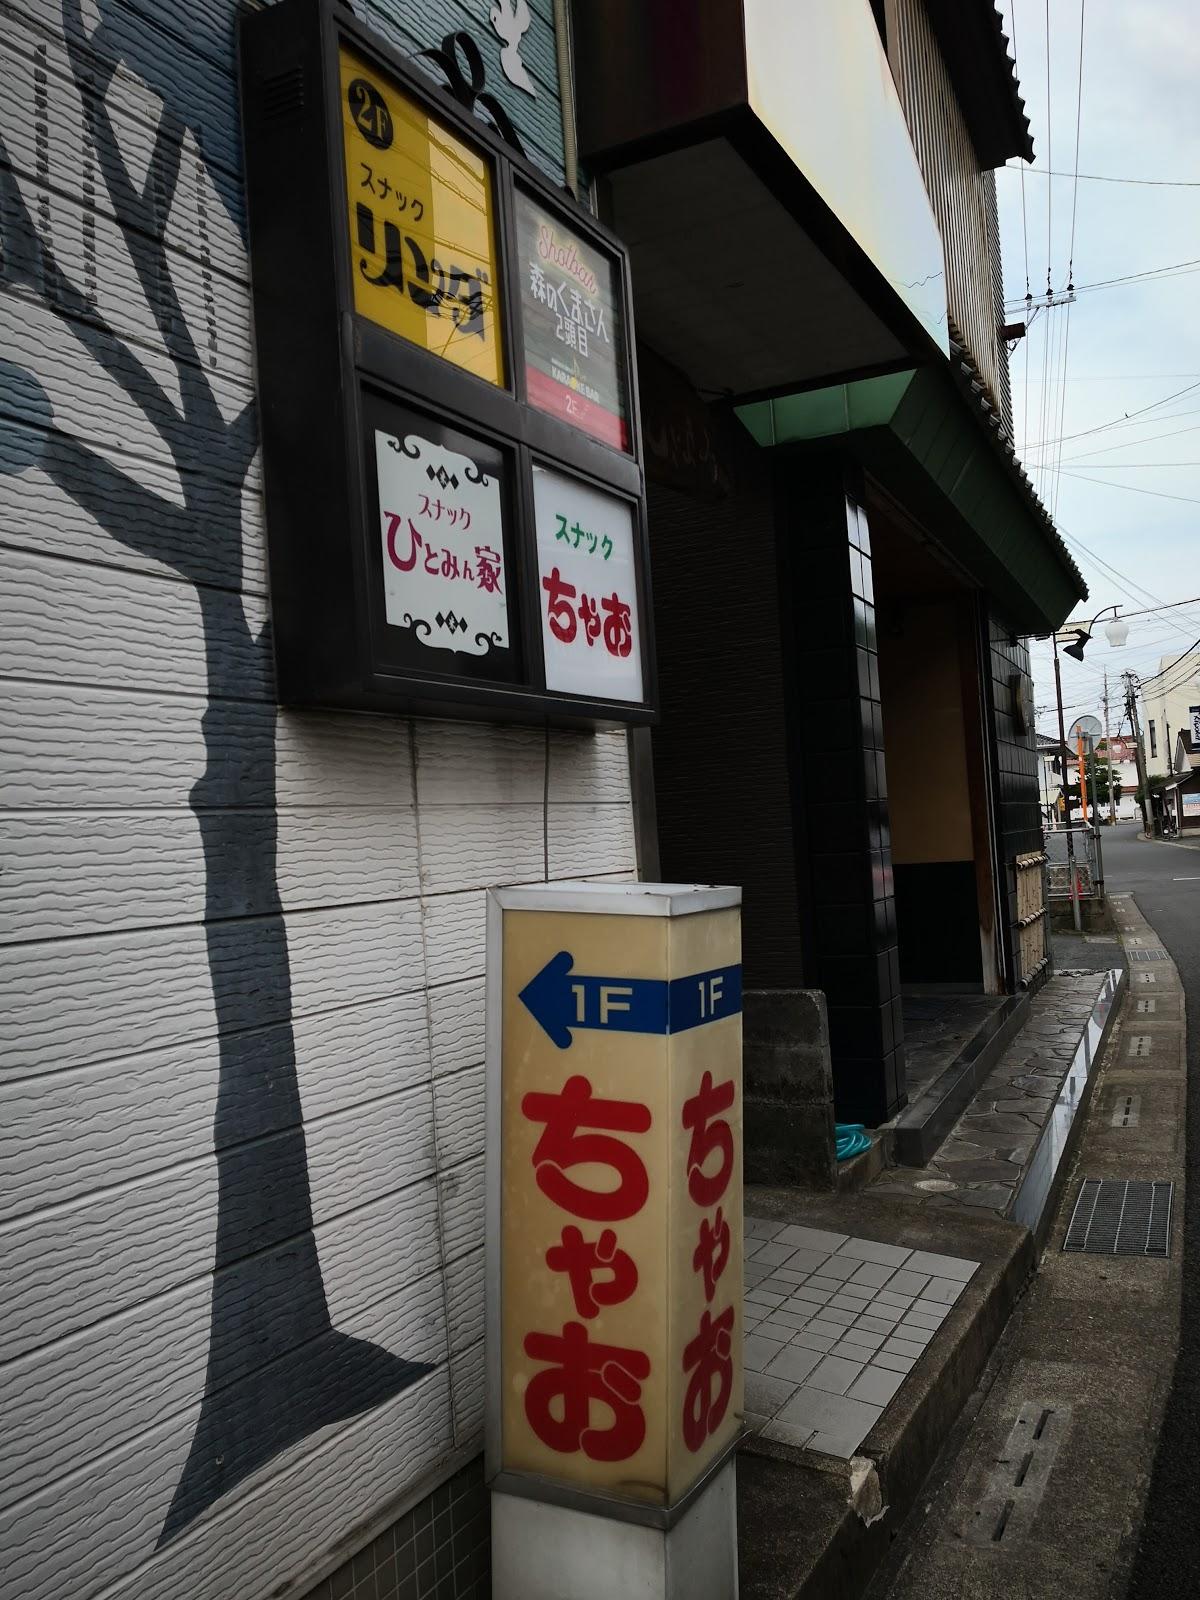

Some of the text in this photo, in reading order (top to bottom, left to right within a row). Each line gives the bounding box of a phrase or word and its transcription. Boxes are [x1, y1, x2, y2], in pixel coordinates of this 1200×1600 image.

[355, 85, 389, 142] 2F
[360, 162, 424, 222] スナック
[529, 262, 610, 344] 森のくまさん
[418, 493, 471, 530] スナック
[555, 513, 613, 560] スナック
[384, 510, 503, 595] ひとみん家
[542, 567, 632, 657] ちゃお
[572, 984, 633, 1024] 1F
[698, 976, 724, 1018] 1F
[521, 1074, 651, 1462] ちゃお
[682, 1070, 735, 1453] ちゃお
